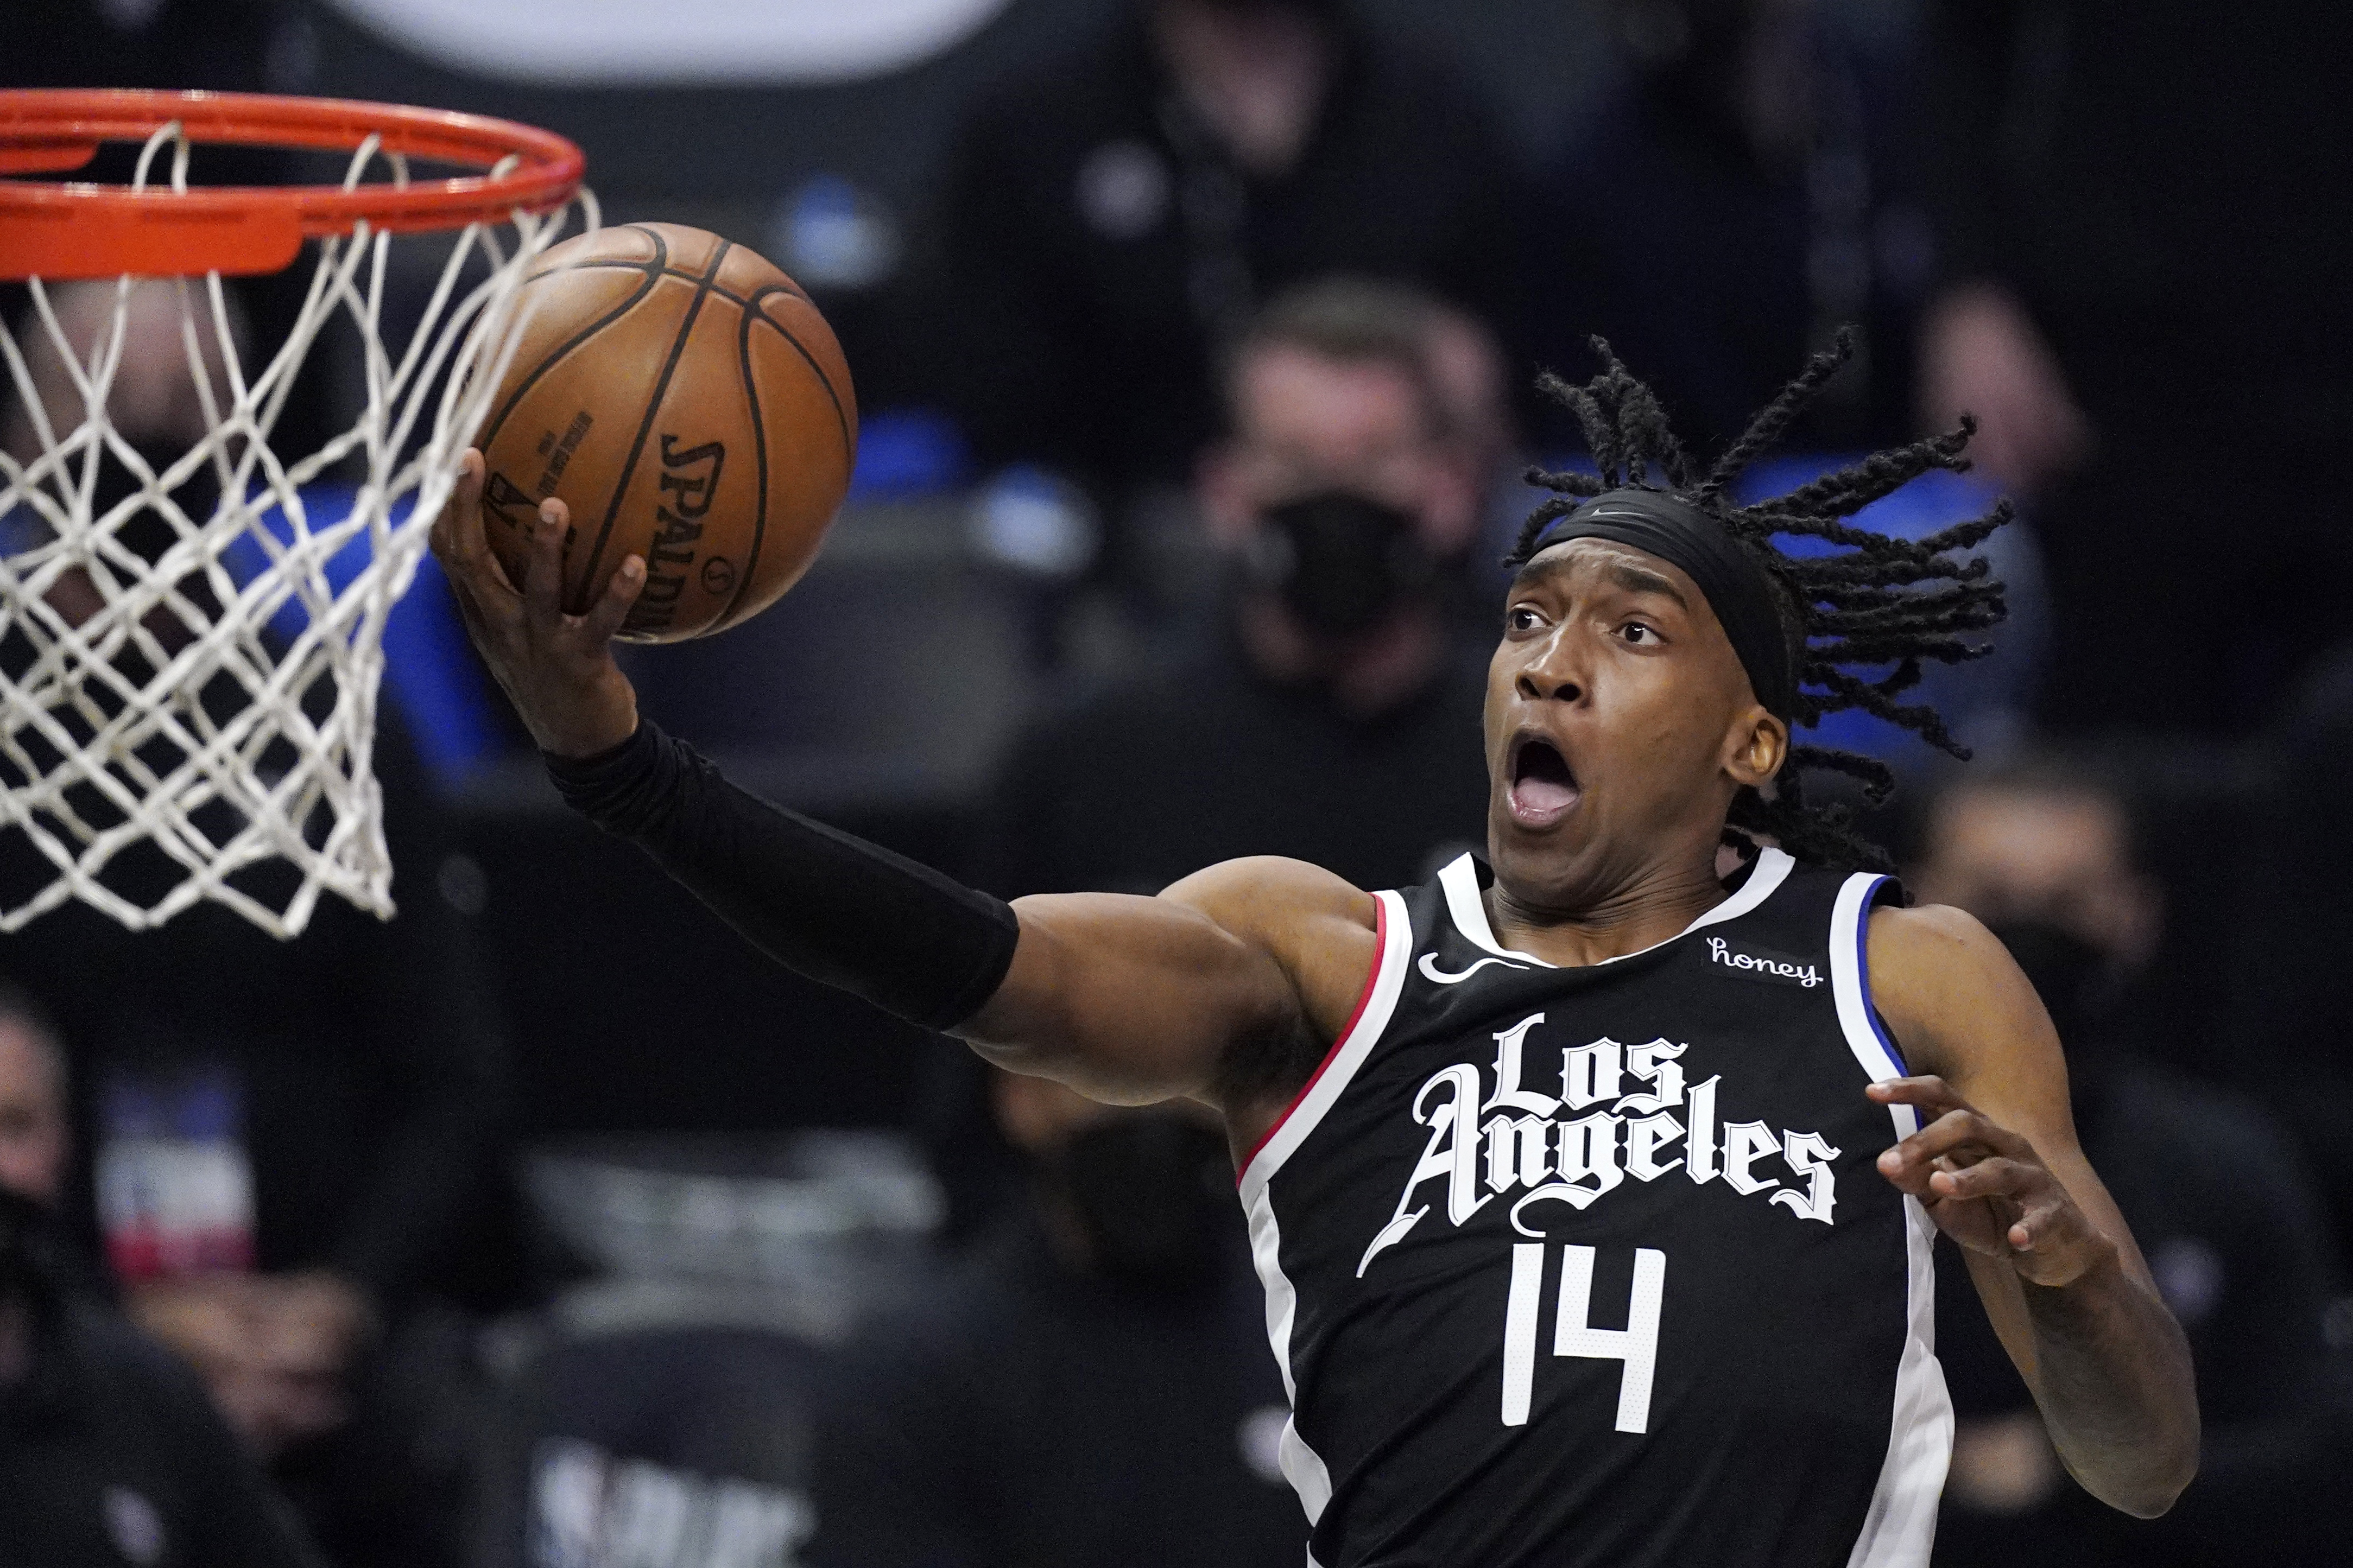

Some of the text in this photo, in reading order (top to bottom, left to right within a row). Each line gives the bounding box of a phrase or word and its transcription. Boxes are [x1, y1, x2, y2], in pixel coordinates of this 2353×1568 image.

[1706, 937, 1824, 987] honey
[1481, 1012, 1688, 1116] Los
[1356, 1063, 1842, 1278] Angeles
[1501, 1242, 1666, 1434] 14
